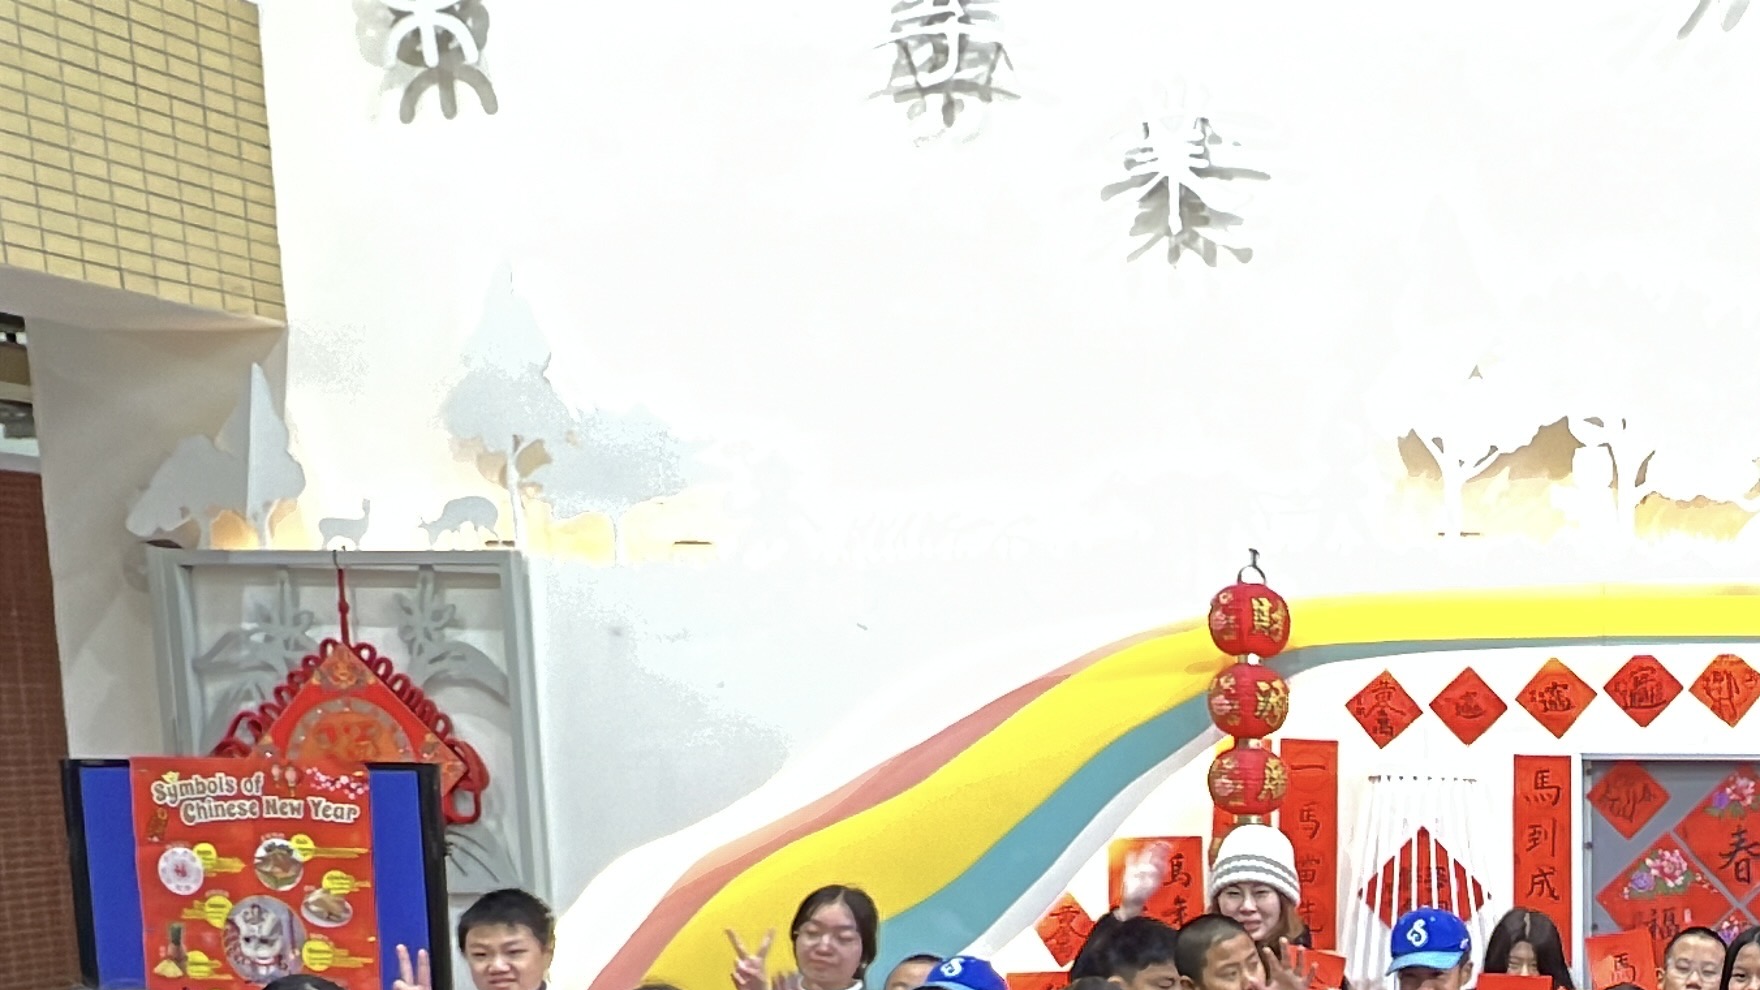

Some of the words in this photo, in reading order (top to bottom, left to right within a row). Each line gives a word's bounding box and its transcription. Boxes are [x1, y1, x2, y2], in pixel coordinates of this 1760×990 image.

[153, 773, 237, 803] Symbols
[242, 772, 264, 794] of
[181, 798, 258, 824] Chinese
[264, 797, 305, 818] New
[310, 799, 360, 823] Year
